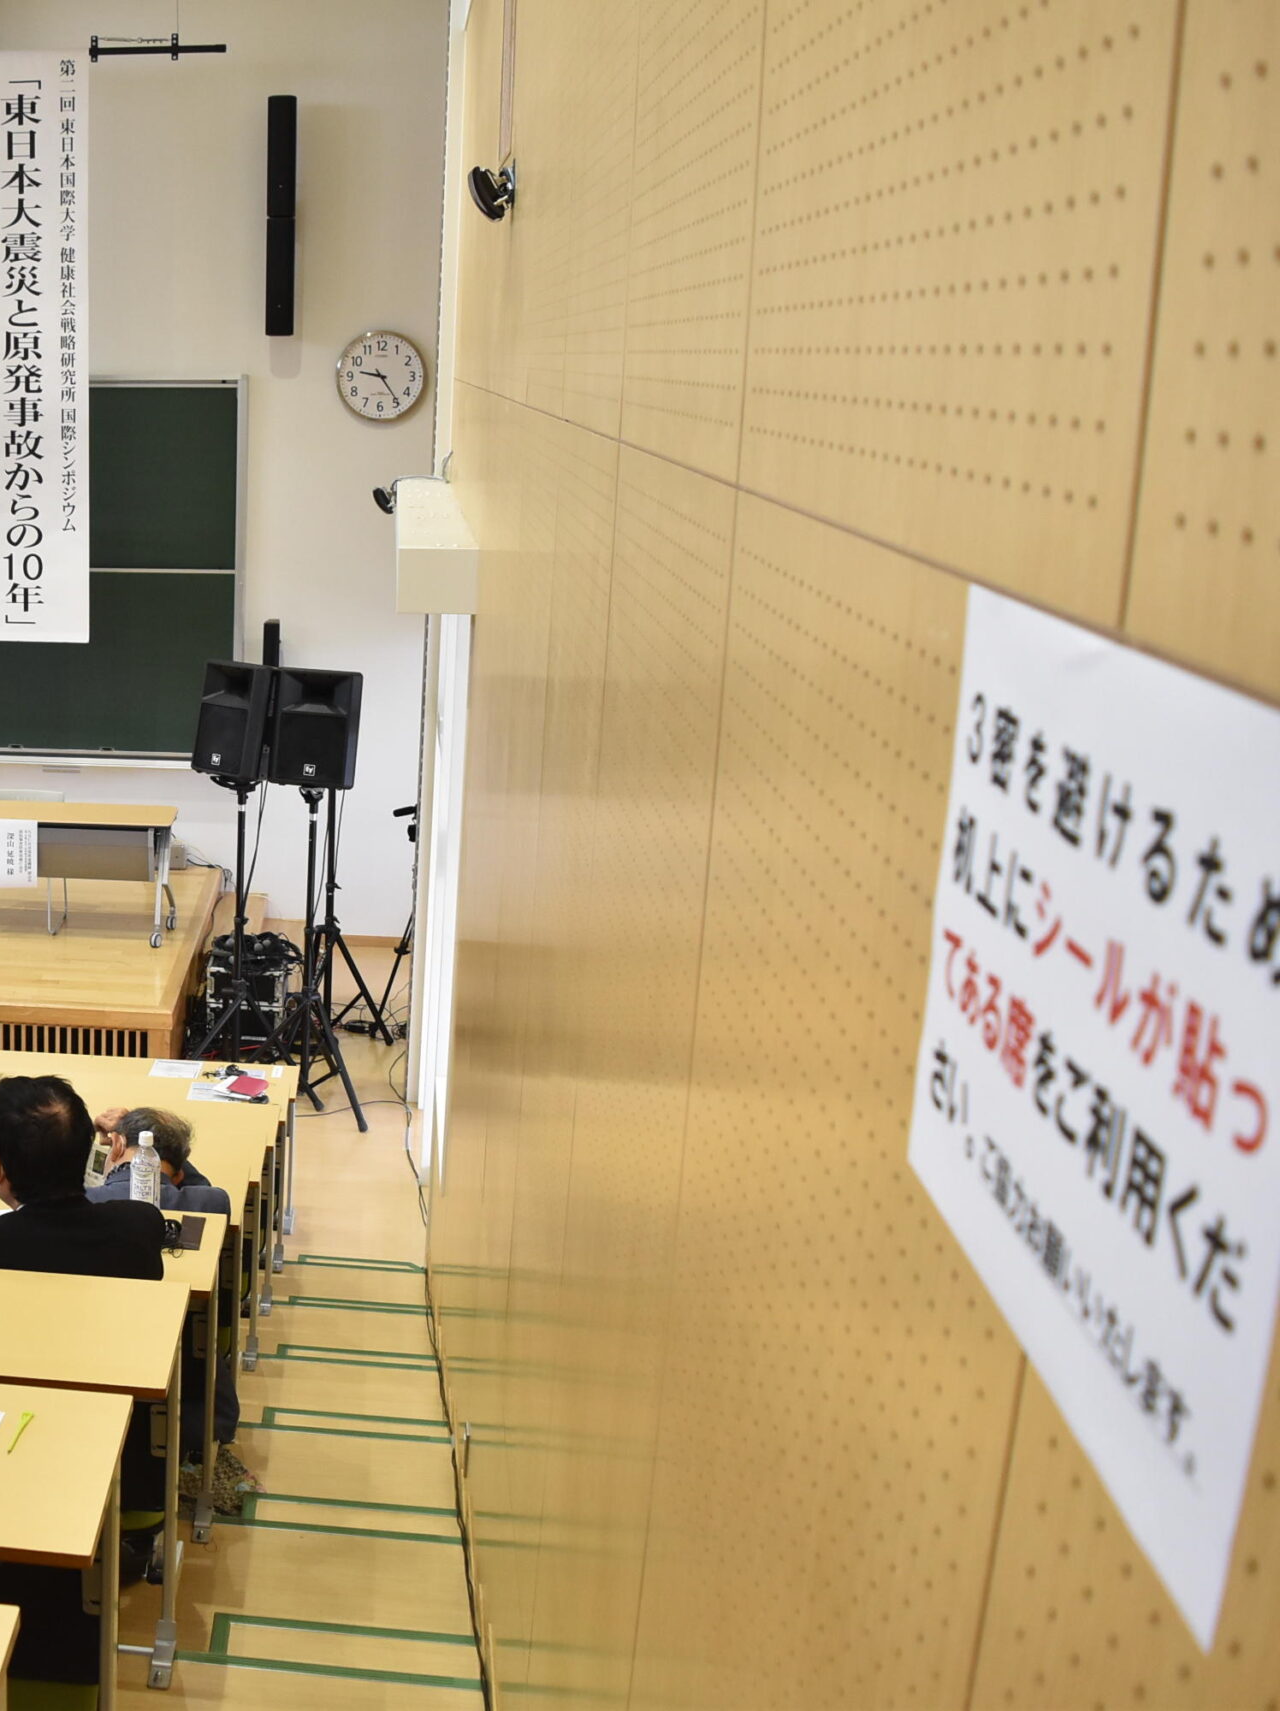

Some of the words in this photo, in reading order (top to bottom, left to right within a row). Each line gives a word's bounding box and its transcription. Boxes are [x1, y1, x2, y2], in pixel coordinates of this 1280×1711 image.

[59, 59, 76, 112] 第二回
[59, 117, 76, 241] 東日本国際大学
[59, 247, 77, 402] 健康社会戦略研究所
[363, 345, 372, 355] 11
[376, 340, 388, 351] 12
[0, 79, 45, 625] 「東日本大震災と原発事故からの10年」
[351, 356, 363, 367] 10
[404, 355, 412, 366] 2
[346, 371, 354, 382] 9
[408, 371, 416, 382] 3
[350, 386, 358, 397] 8
[403, 386, 411, 397] 4
[362, 397, 369, 408] 7
[376, 401, 384, 412] 6
[392, 397, 400, 408] 5
[60, 408, 77, 532] 国際シンポジウム
[951, 805, 1269, 1156] 机上にシールが貼っ
[942, 927, 1249, 1337] てある席をご利用くだ
